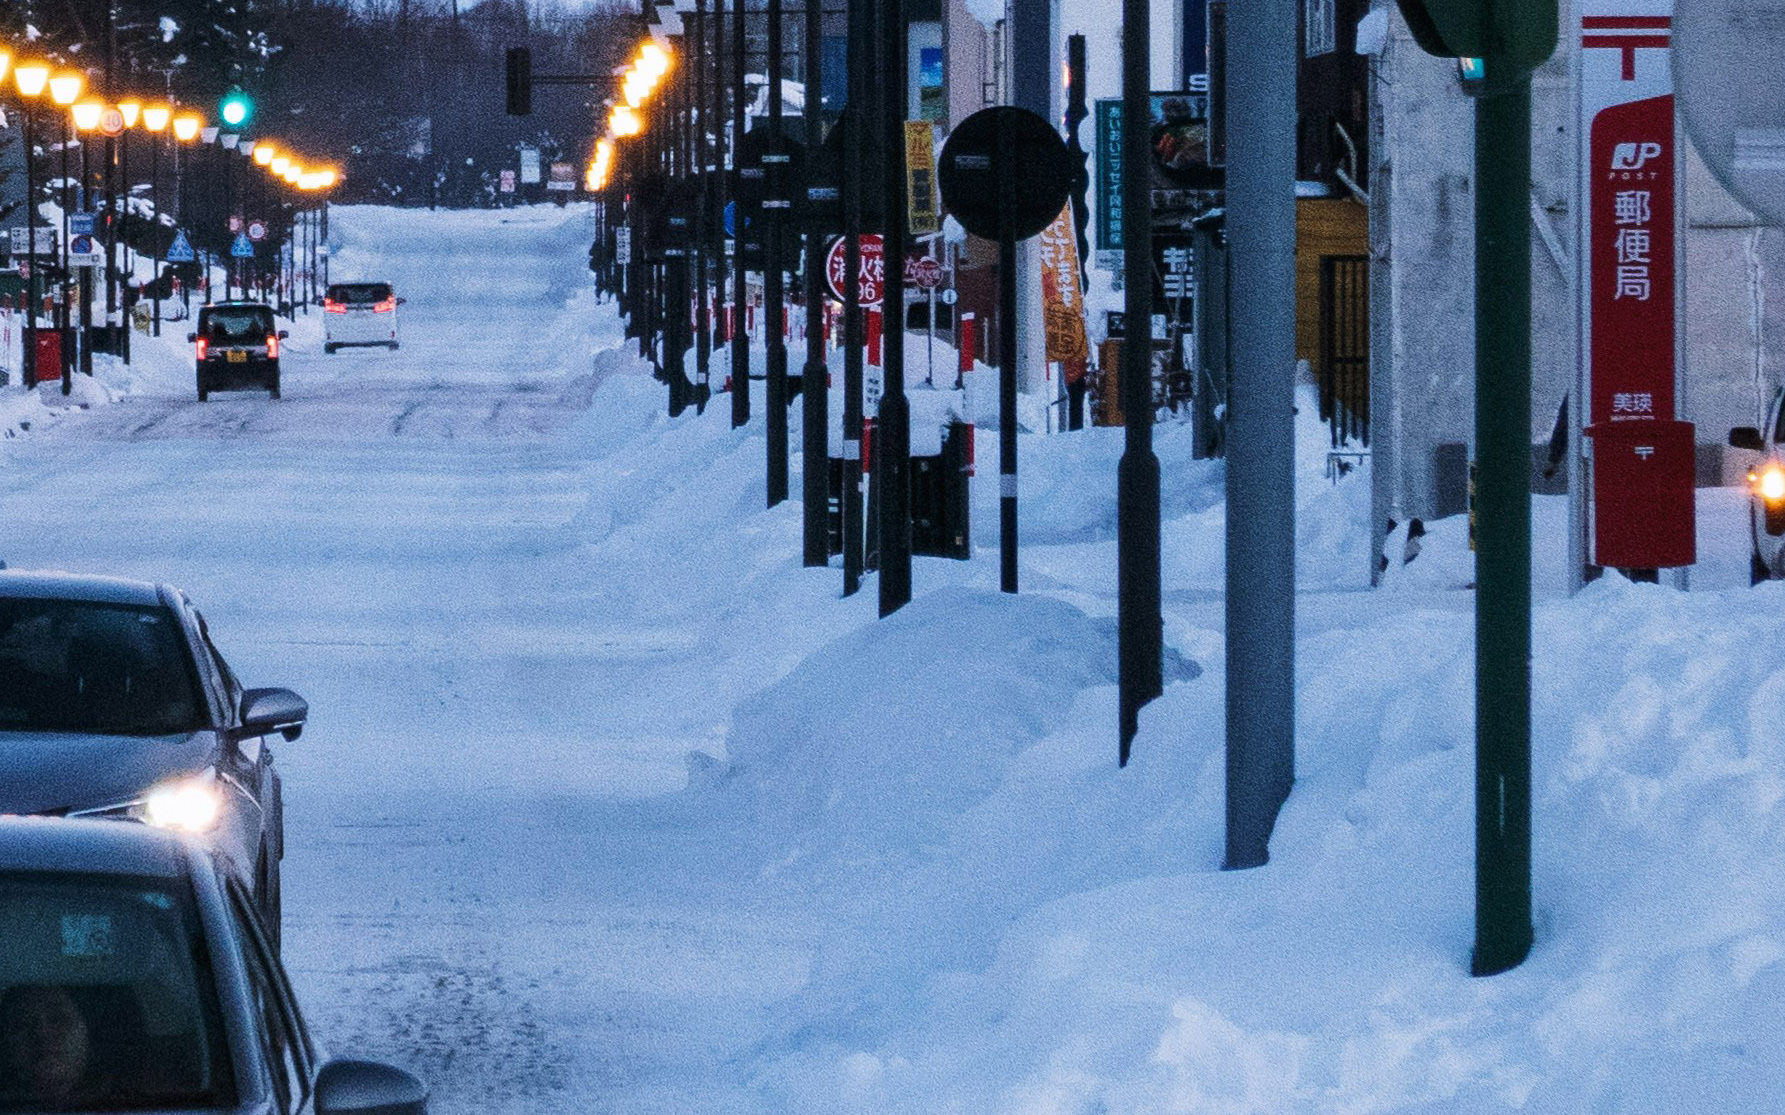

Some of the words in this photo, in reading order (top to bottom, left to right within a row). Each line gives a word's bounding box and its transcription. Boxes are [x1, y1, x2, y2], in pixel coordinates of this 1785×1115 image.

[1611, 142, 1662, 171] JP
[1607, 172, 1658, 181] POST
[1613, 189, 1652, 301] 郵便局
[1612, 392, 1653, 413] 美瑛
